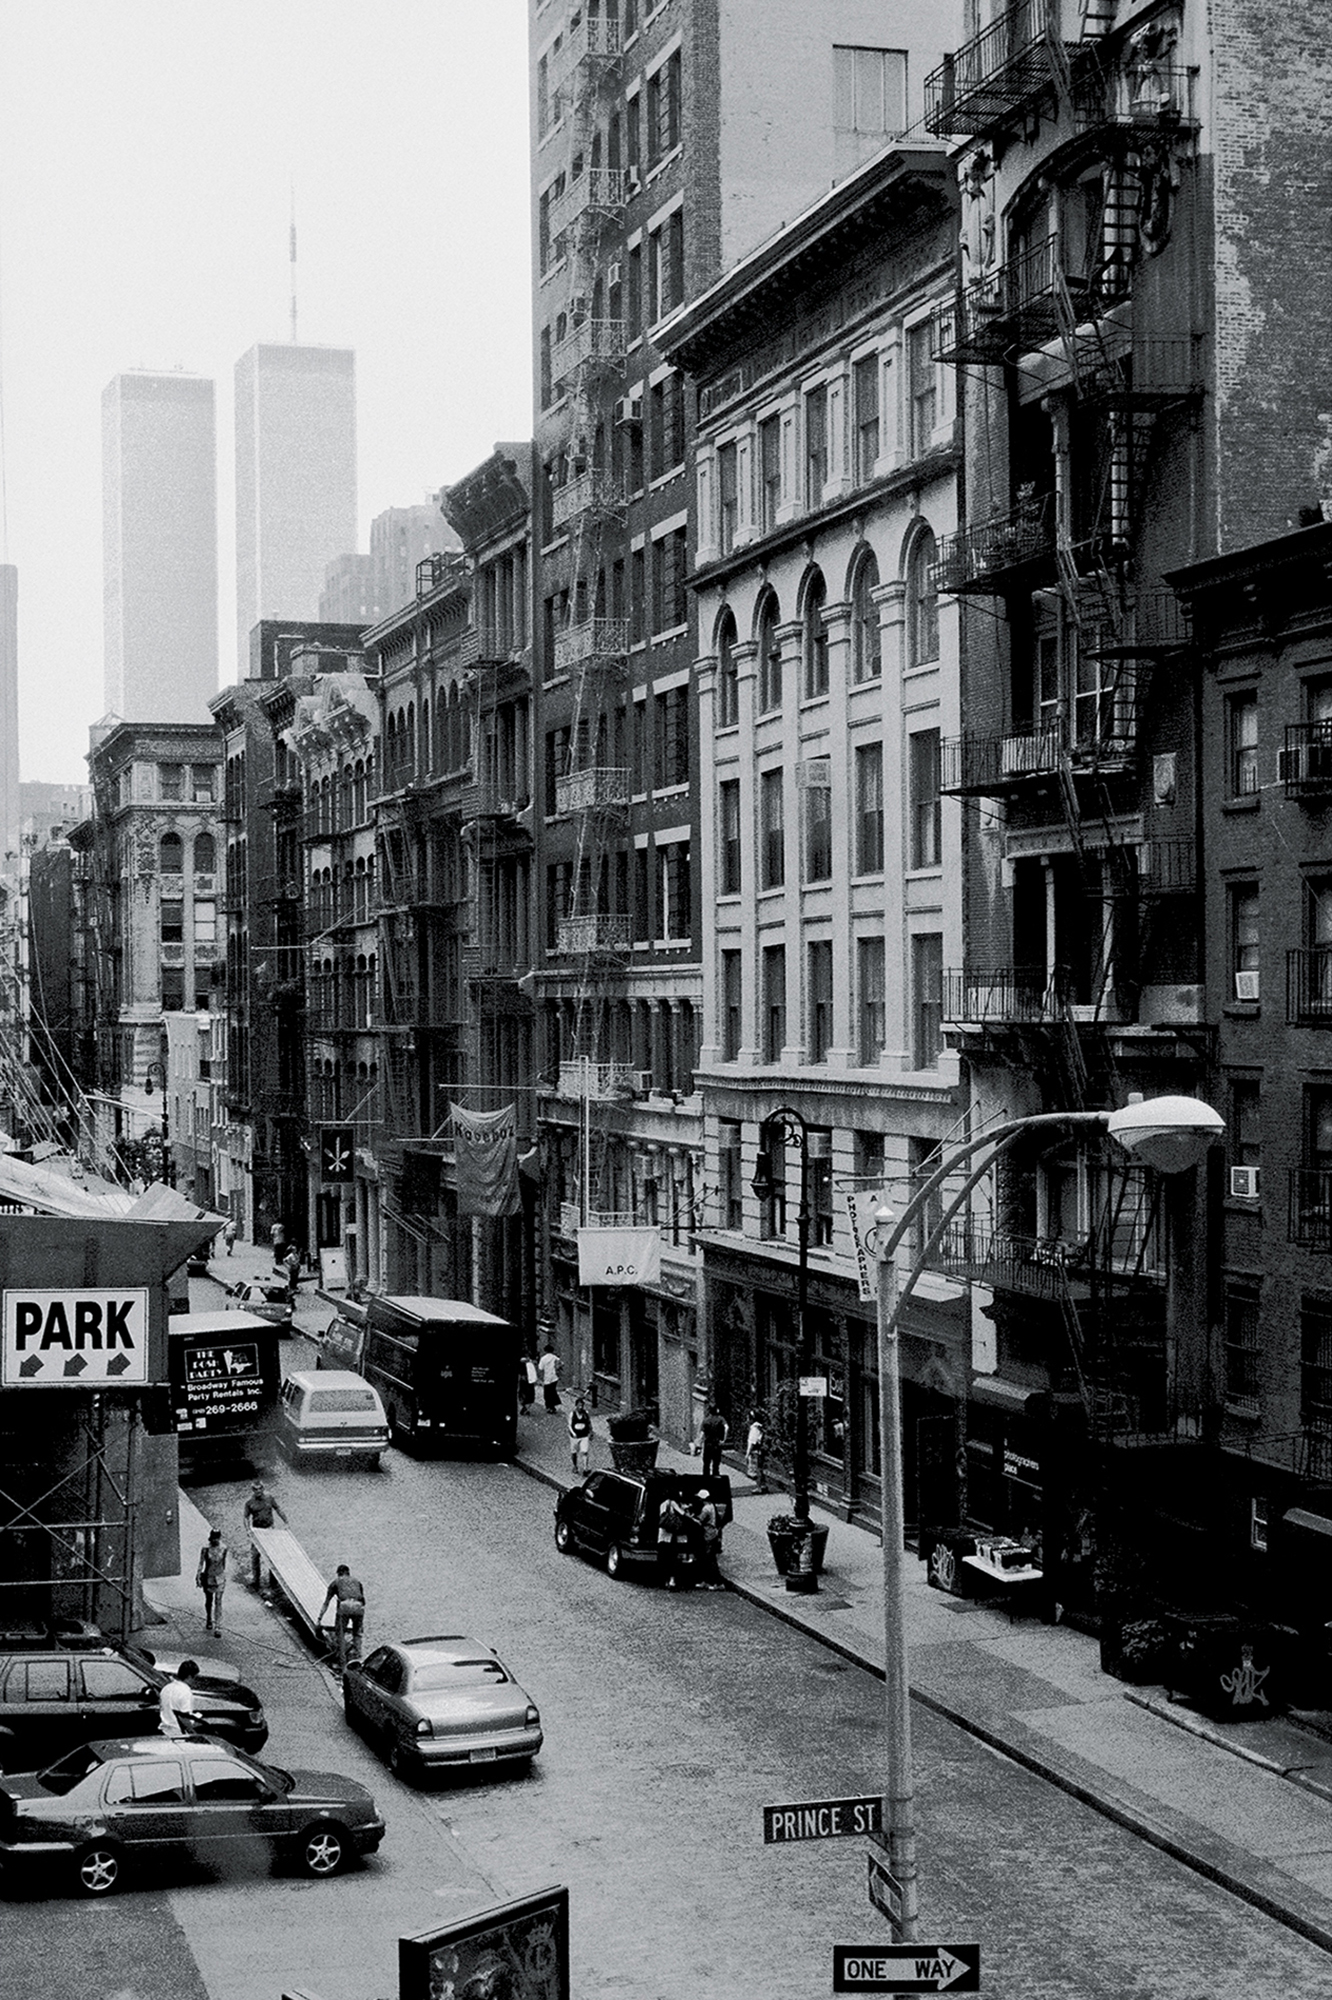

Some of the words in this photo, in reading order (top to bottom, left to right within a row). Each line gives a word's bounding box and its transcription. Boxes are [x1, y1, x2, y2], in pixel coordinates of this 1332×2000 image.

[846, 1195, 871, 1295] PHOTOGRAPHERS
[605, 1264, 638, 1276] A.P.C.
[15, 1300, 136, 1351] PARK
[197, 1351, 214, 1359] THE
[190, 1369, 223, 1379] PARTY
[187, 1382, 228, 1392] Broadway
[231, 1379, 263, 1387] Famous
[212, 1389, 244, 1398] Rentals
[772, 1807, 842, 1841] PRINCE
[854, 1804, 875, 1832] ST
[846, 1959, 887, 1980] ONE
[914, 1958, 957, 1979] WAY
